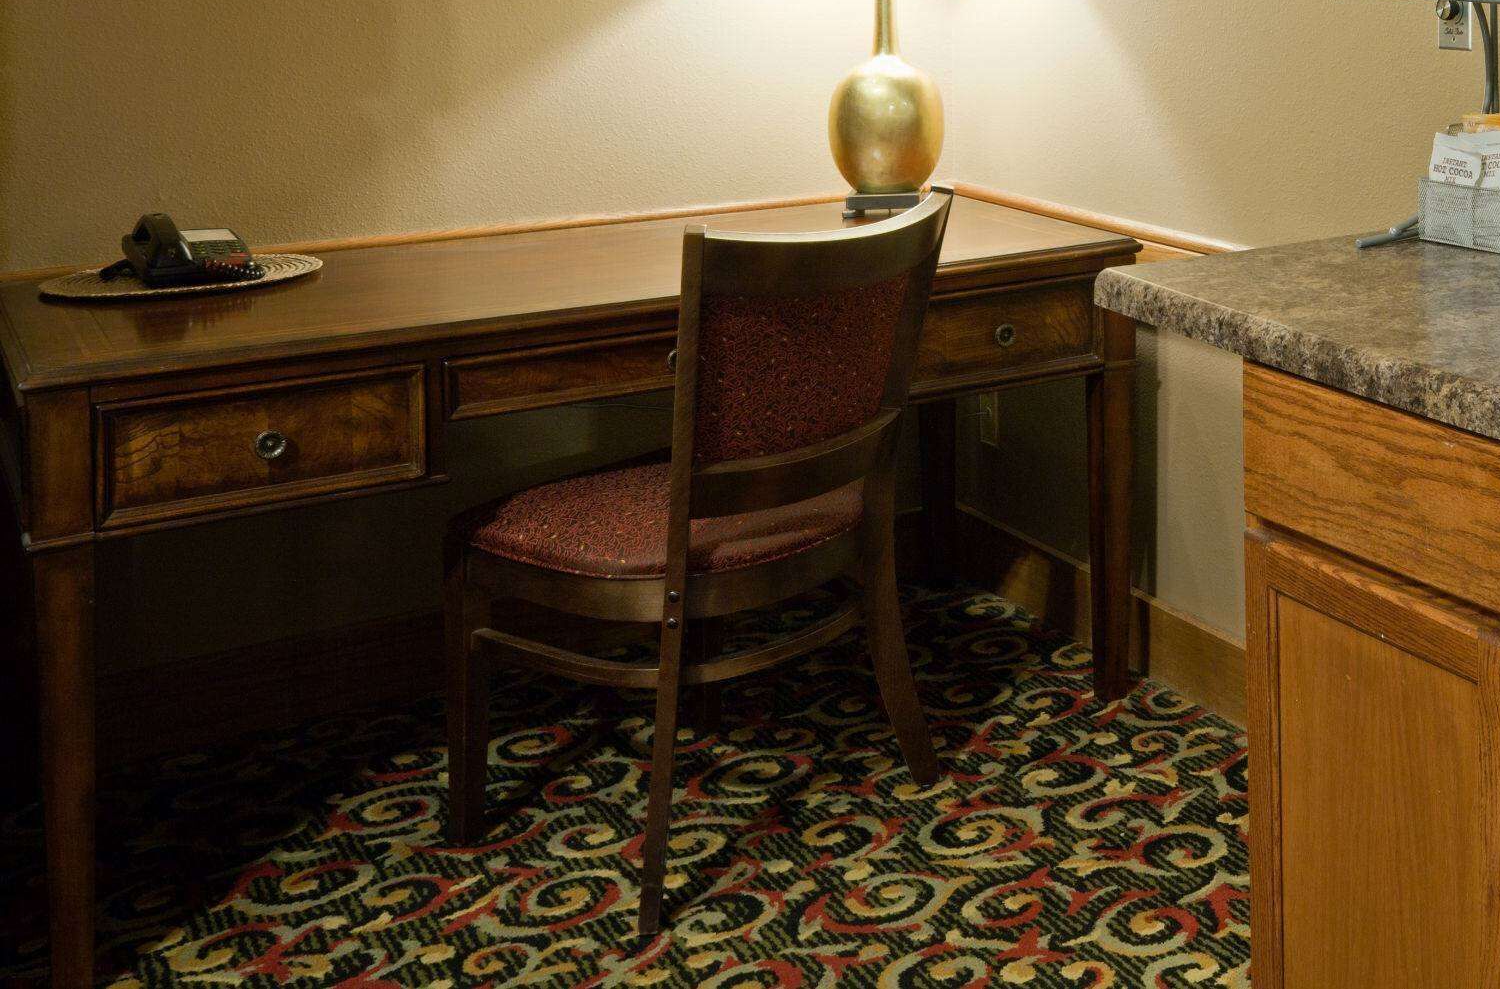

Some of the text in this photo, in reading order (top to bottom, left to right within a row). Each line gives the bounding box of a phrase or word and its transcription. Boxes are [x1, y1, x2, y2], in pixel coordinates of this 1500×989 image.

[1442, 157, 1469, 169] INSTANT
[1433, 164, 1447, 174] HOT
[1448, 166, 1473, 180] COCOA
